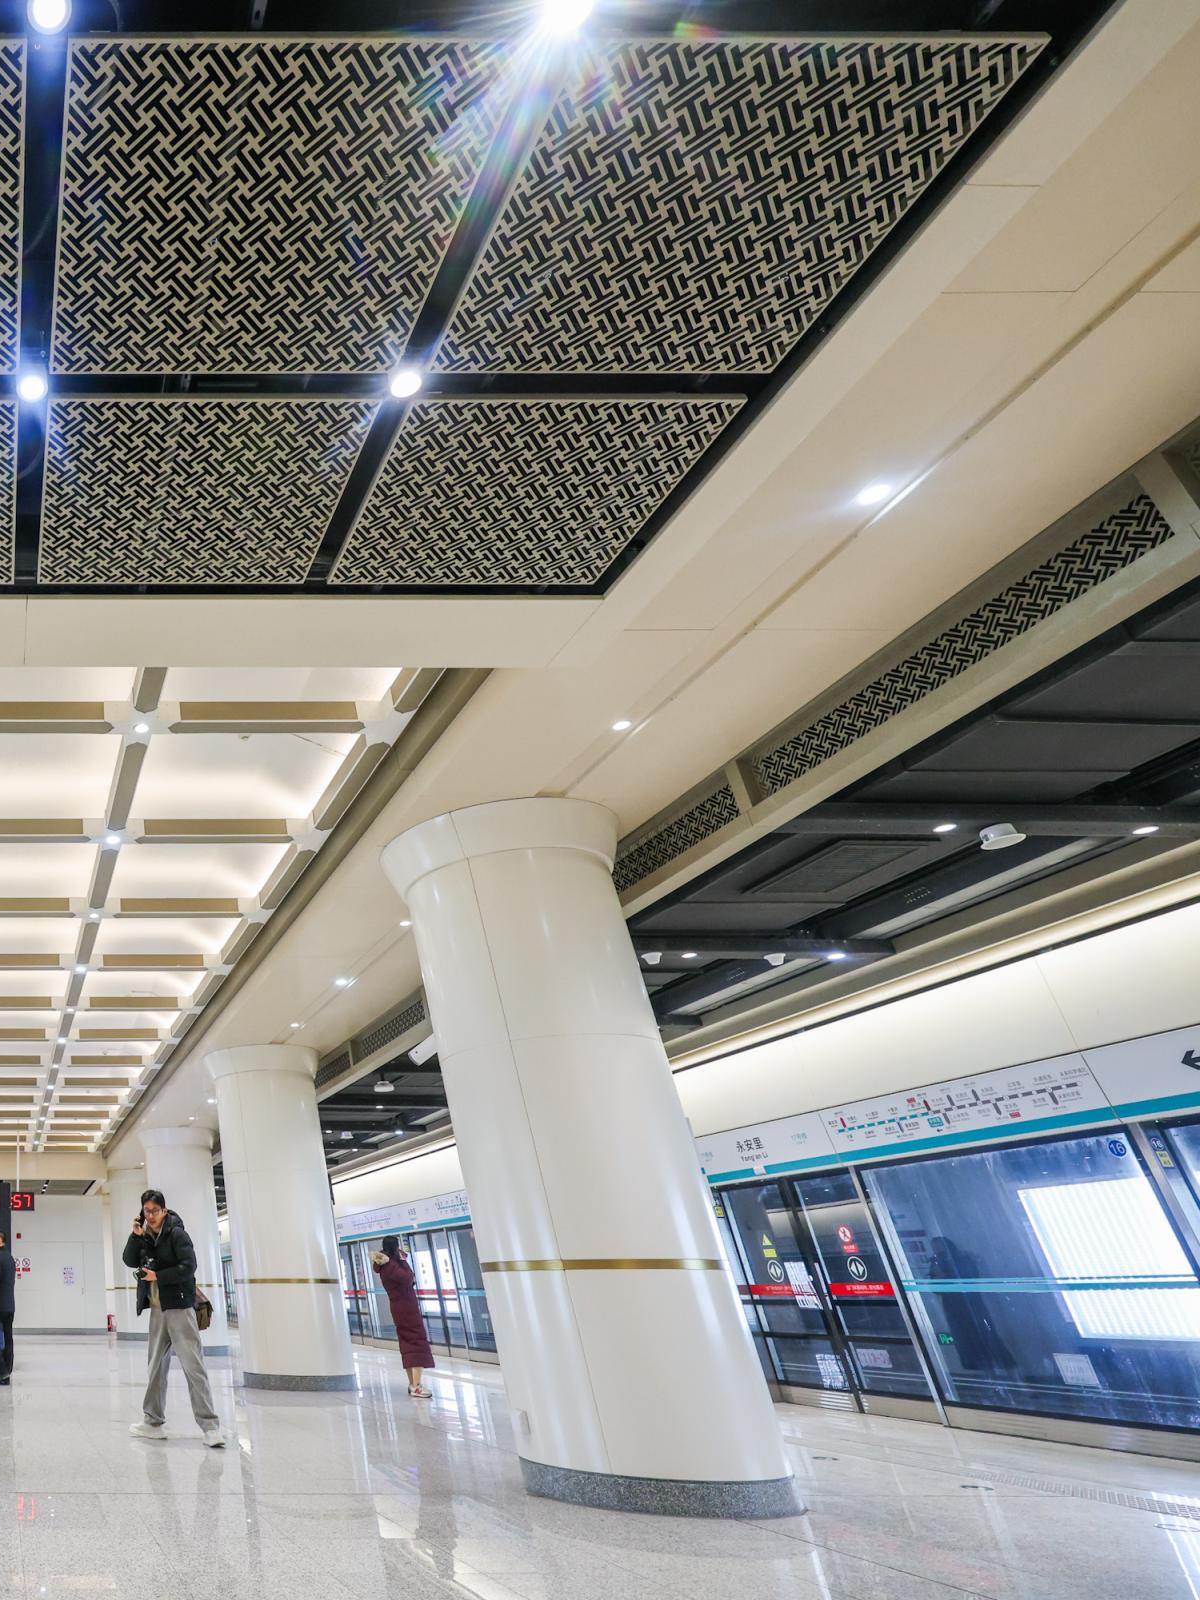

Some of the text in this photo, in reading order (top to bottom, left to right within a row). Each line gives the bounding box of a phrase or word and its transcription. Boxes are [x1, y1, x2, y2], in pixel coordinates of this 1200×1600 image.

[736, 1136, 764, 1152] 永安里
[1110, 1142, 1125, 1155] 16
